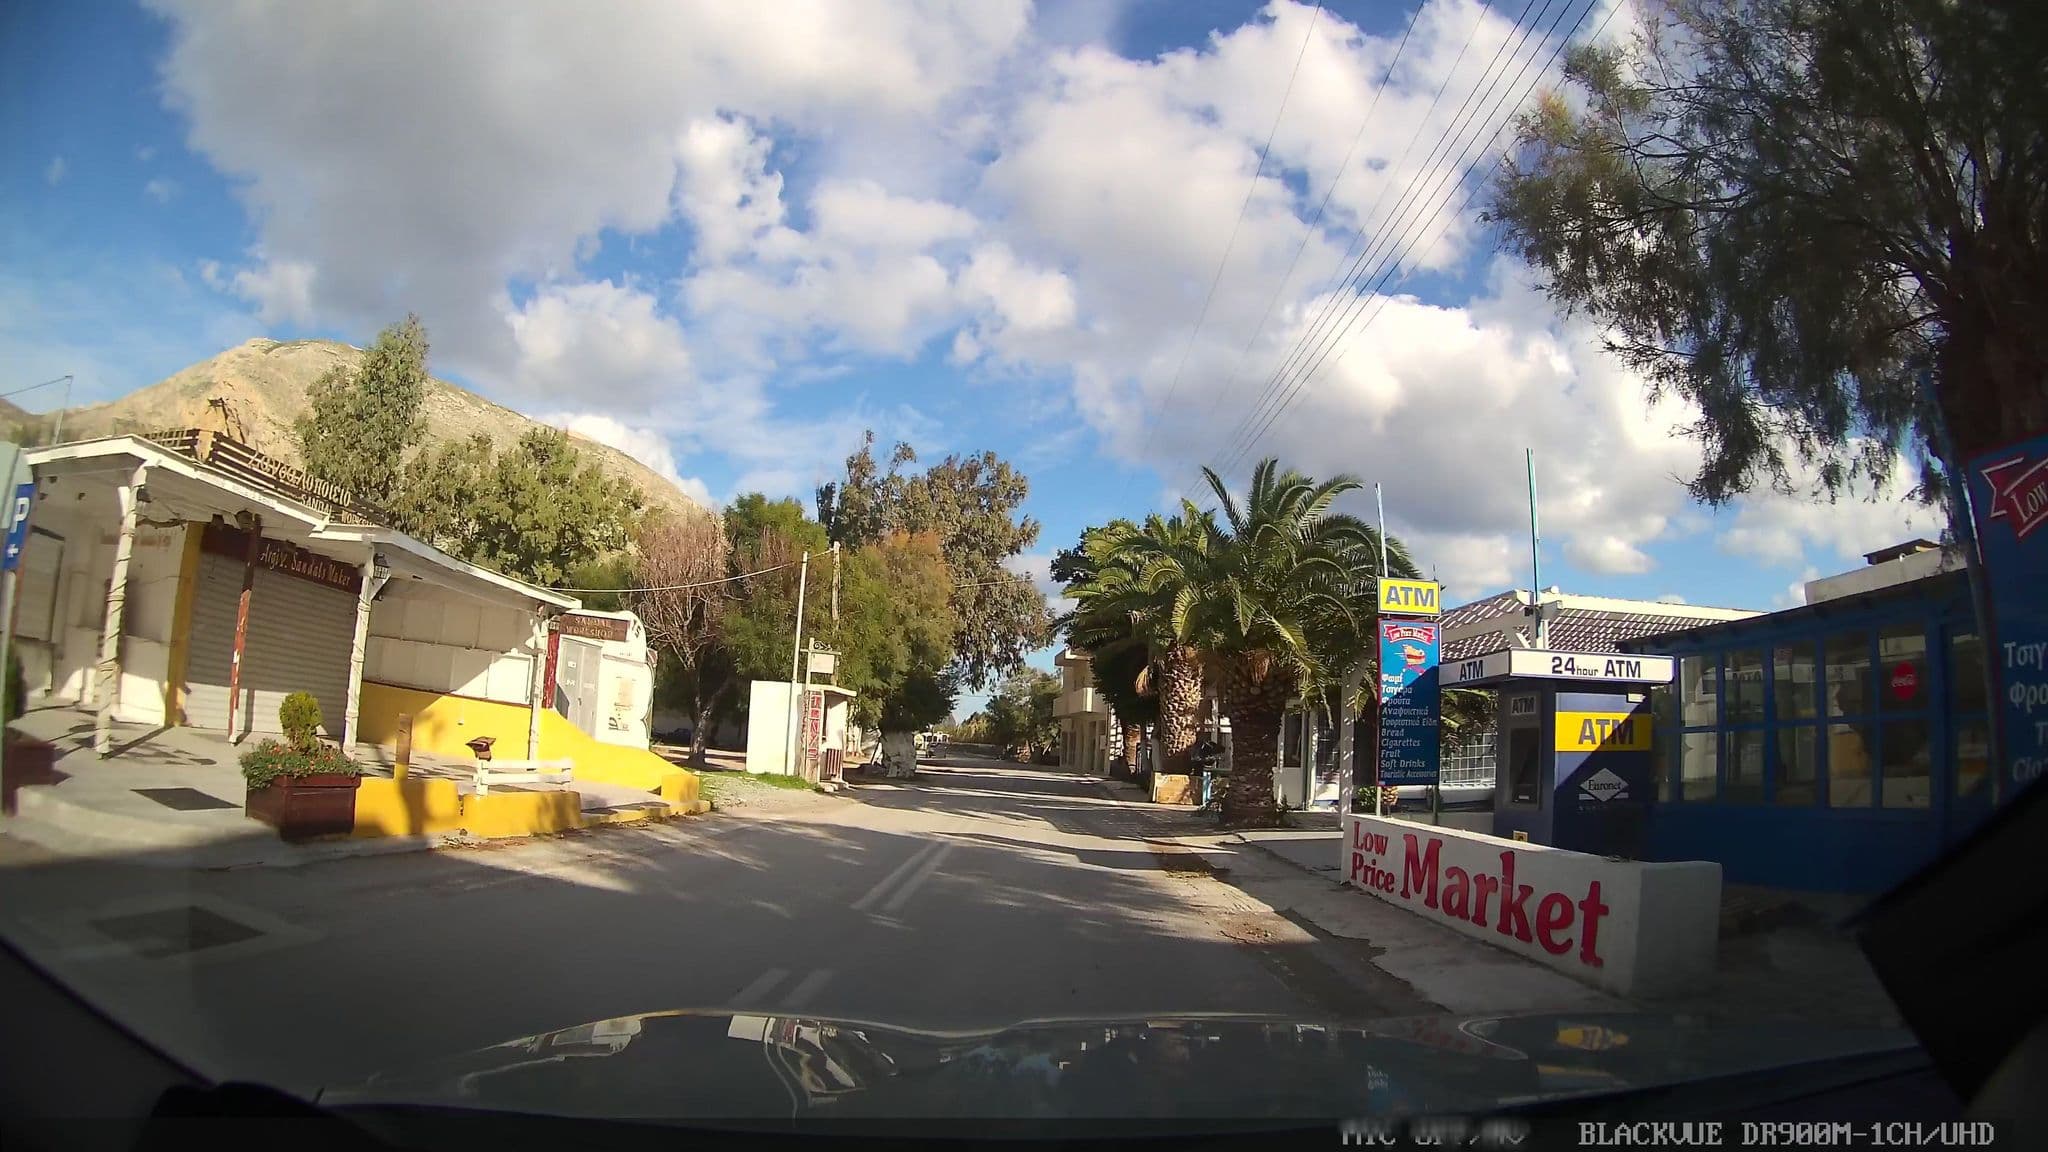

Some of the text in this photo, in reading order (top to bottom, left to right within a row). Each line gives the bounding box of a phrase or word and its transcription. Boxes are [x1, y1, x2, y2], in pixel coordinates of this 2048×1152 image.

[9, 496, 31, 534] P
[291, 551, 326, 580] Sandals
[1385, 585, 1436, 608] ATM
[1459, 659, 1484, 682] ATM
[1604, 659, 1642, 679] ATM
[1511, 696, 1536, 715] ATM
[1381, 728, 1405, 737] Bread
[1578, 718, 1634, 745] ATM
[1380, 748, 1401, 758] Fruit
[1381, 738, 1421, 749] Cigarettes
[1380, 759, 1426, 770] Soft Drinks
[1588, 778, 1622, 792] Euronet
[1352, 820, 1389, 858] Low
[1350, 851, 1396, 895] Price
[1400, 833, 1610, 968] Market
